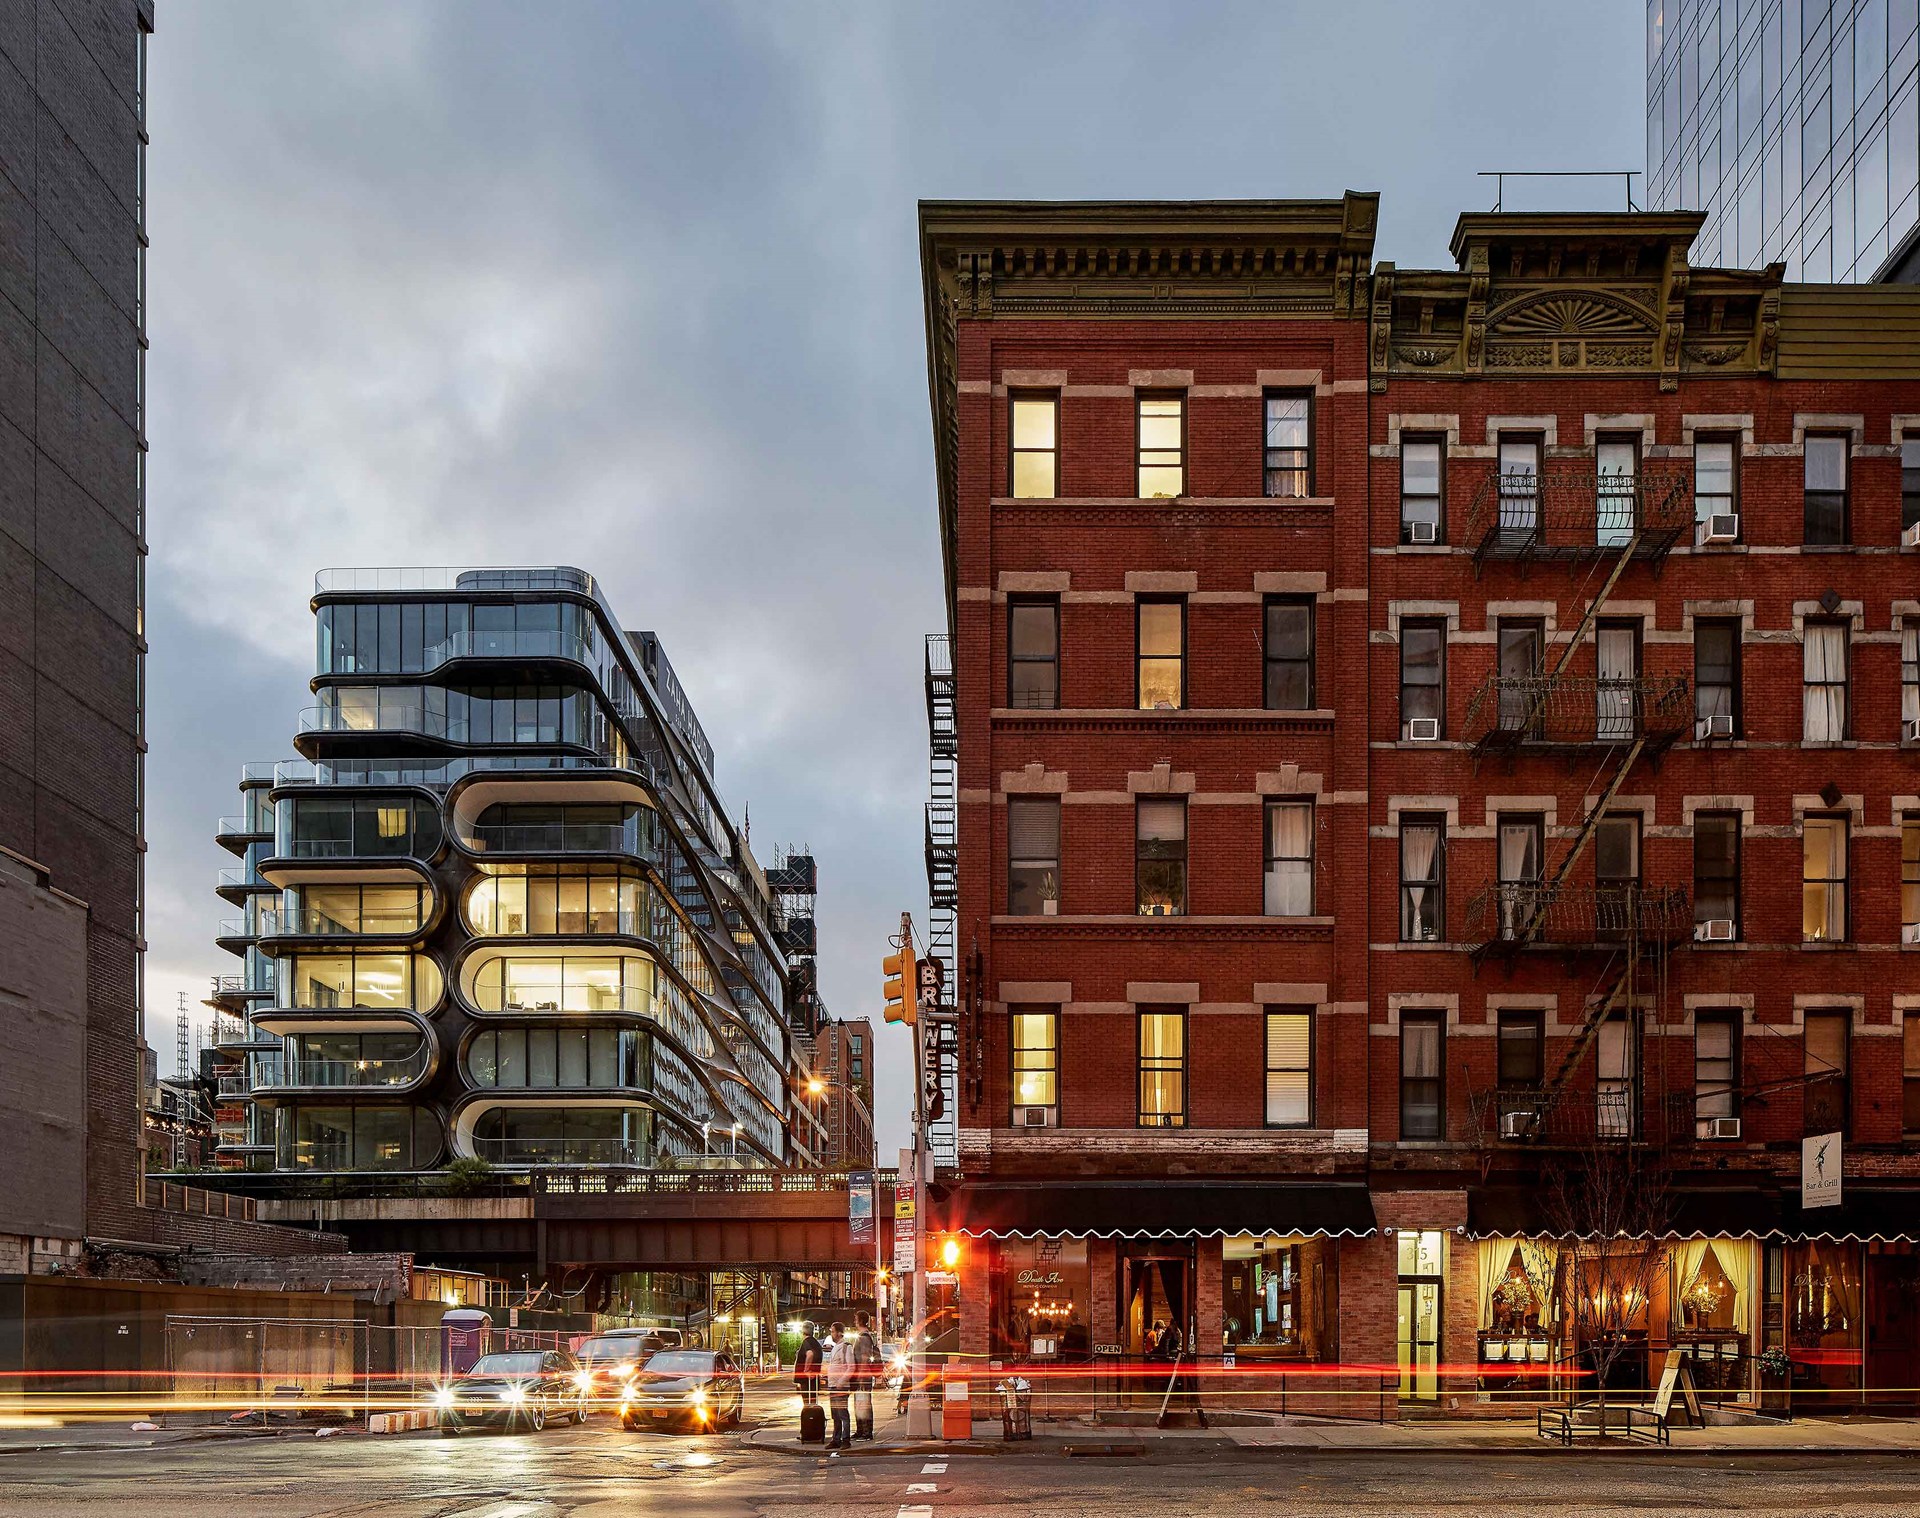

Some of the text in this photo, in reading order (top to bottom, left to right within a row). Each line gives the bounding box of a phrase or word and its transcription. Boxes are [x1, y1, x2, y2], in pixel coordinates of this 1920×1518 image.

[666, 667, 708, 762] ZAHA HADID
[1806, 1179, 1838, 1190] Bar & Grill
[1406, 1247, 1428, 1261] 315
[1017, 1269, 1064, 1283] Death Ave
[1095, 1345, 1121, 1353] OPEN
[1225, 1356, 1233, 1365] A
